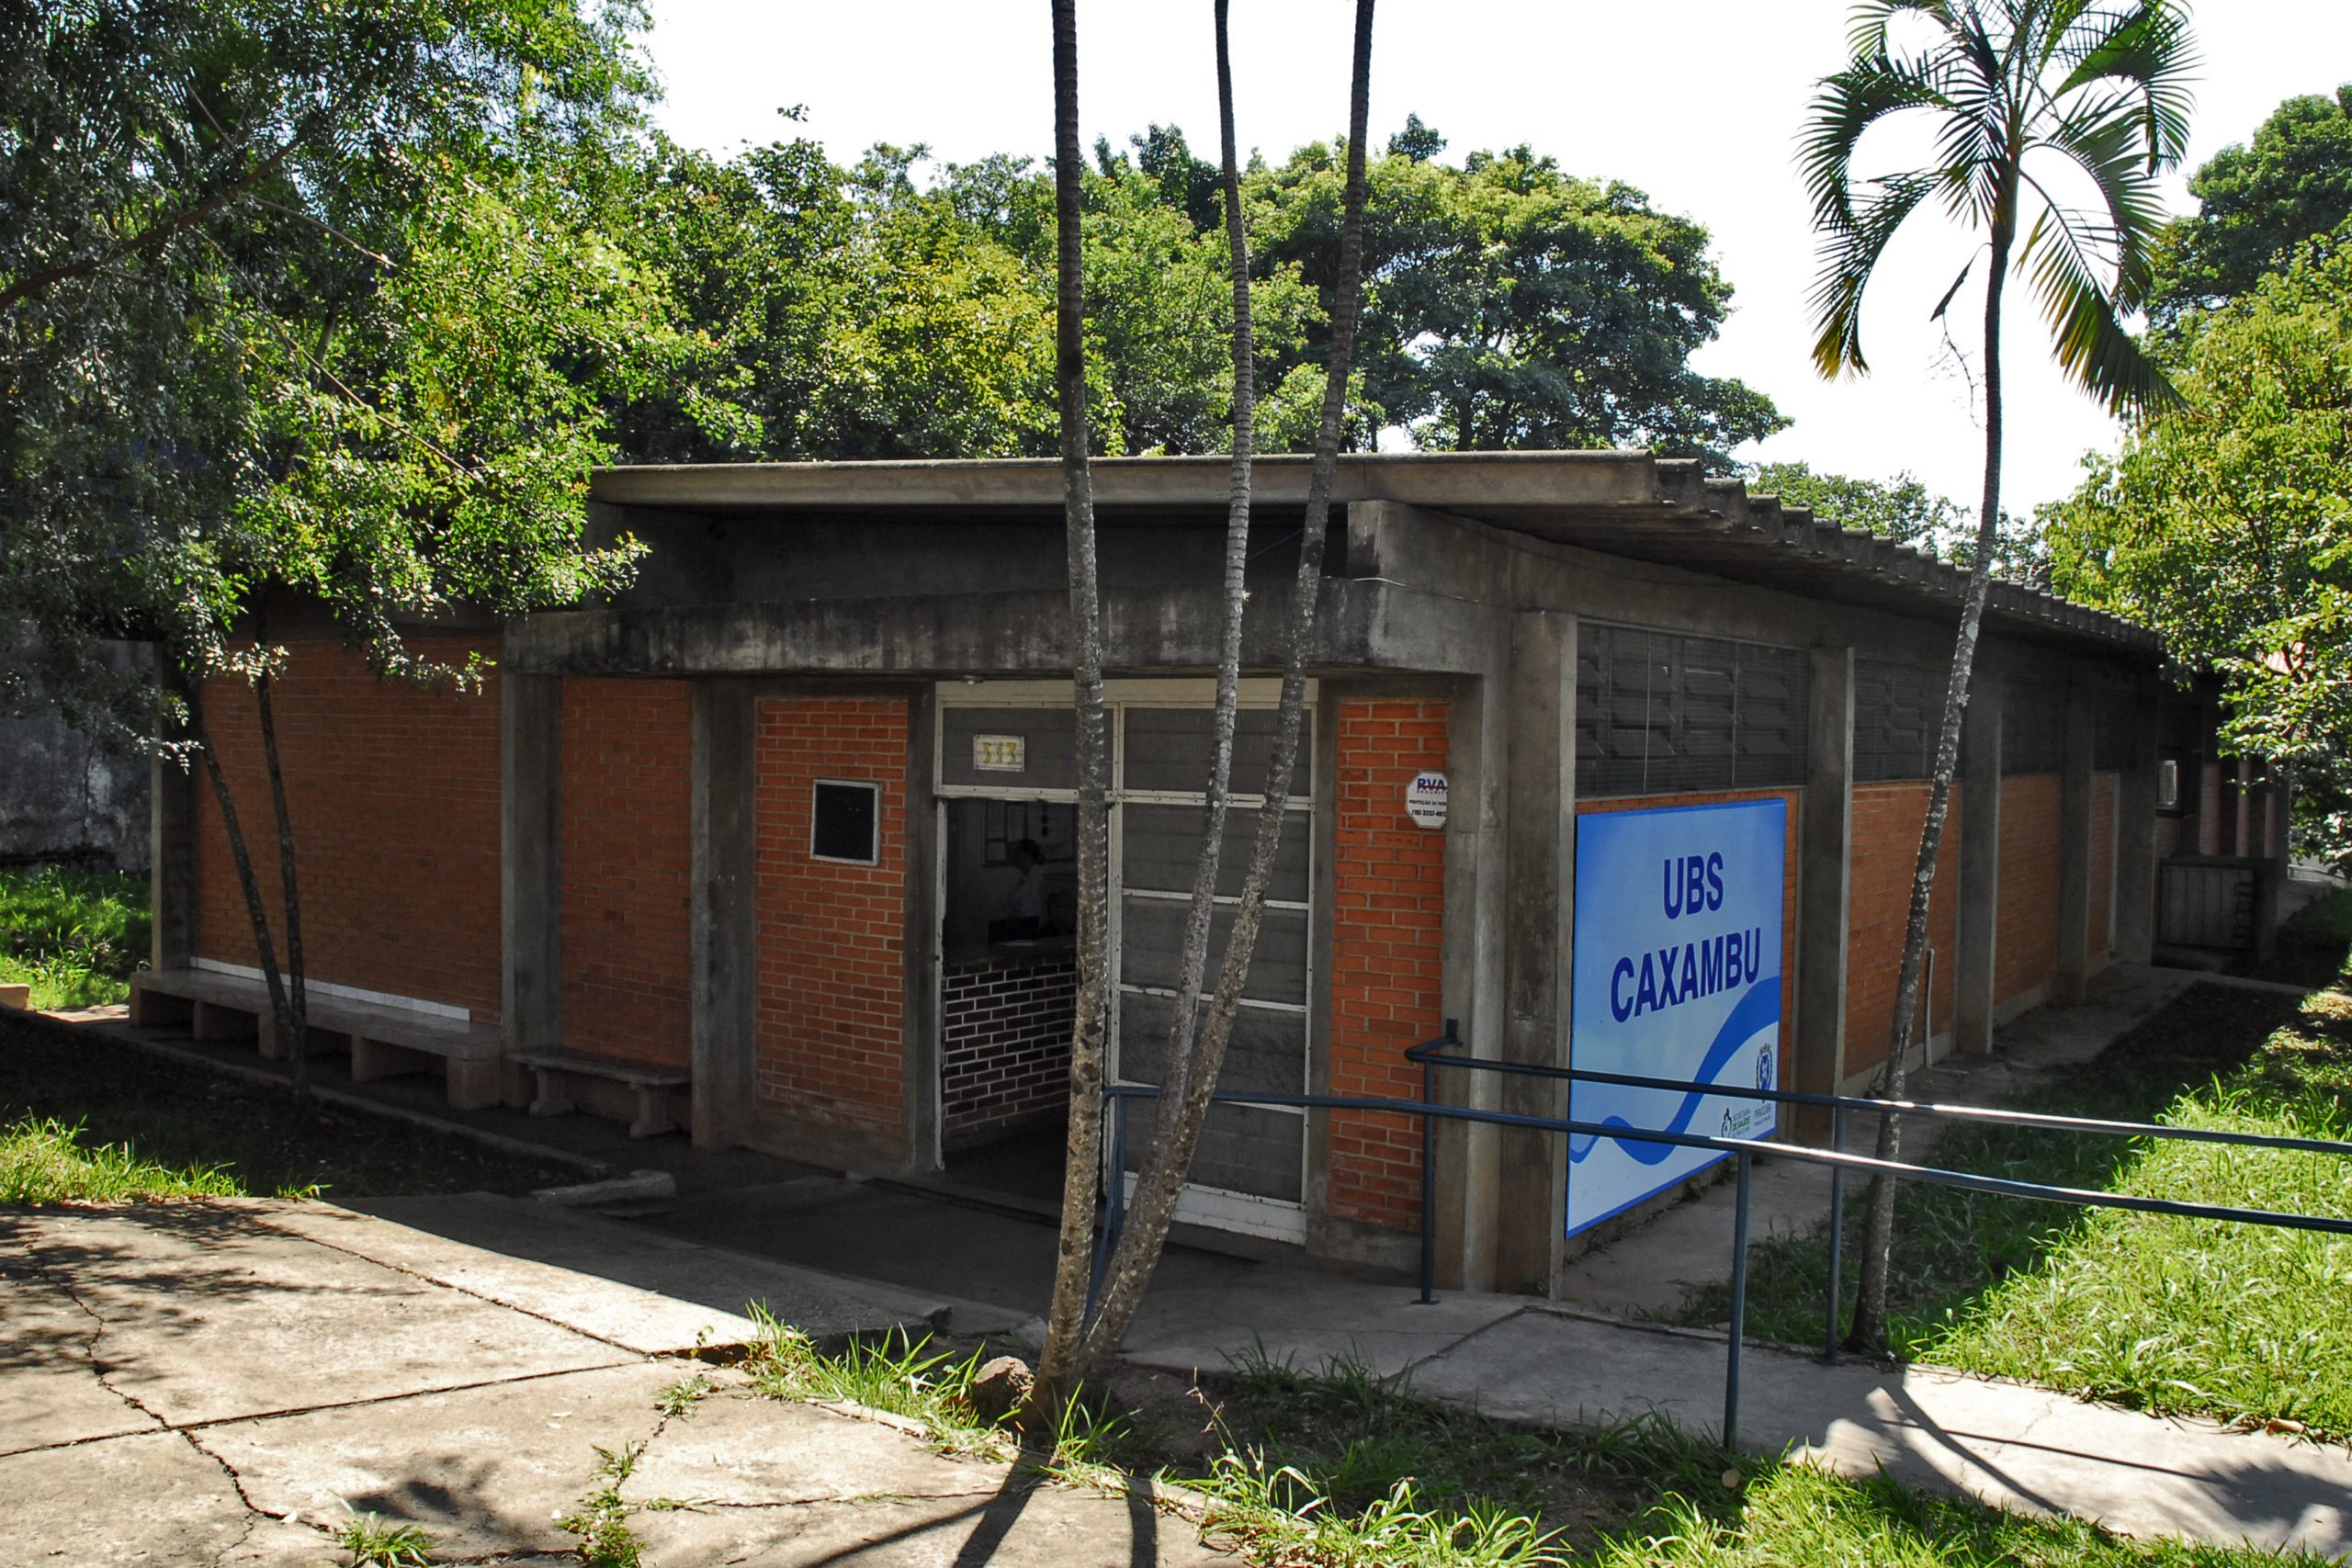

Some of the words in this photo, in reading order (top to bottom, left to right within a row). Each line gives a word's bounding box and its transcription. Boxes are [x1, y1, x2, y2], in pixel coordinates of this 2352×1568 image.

[1417, 778, 1447, 792] RVA
[1664, 852, 1724, 919] UBS
[1611, 927, 1761, 1023] CAXAMBU
